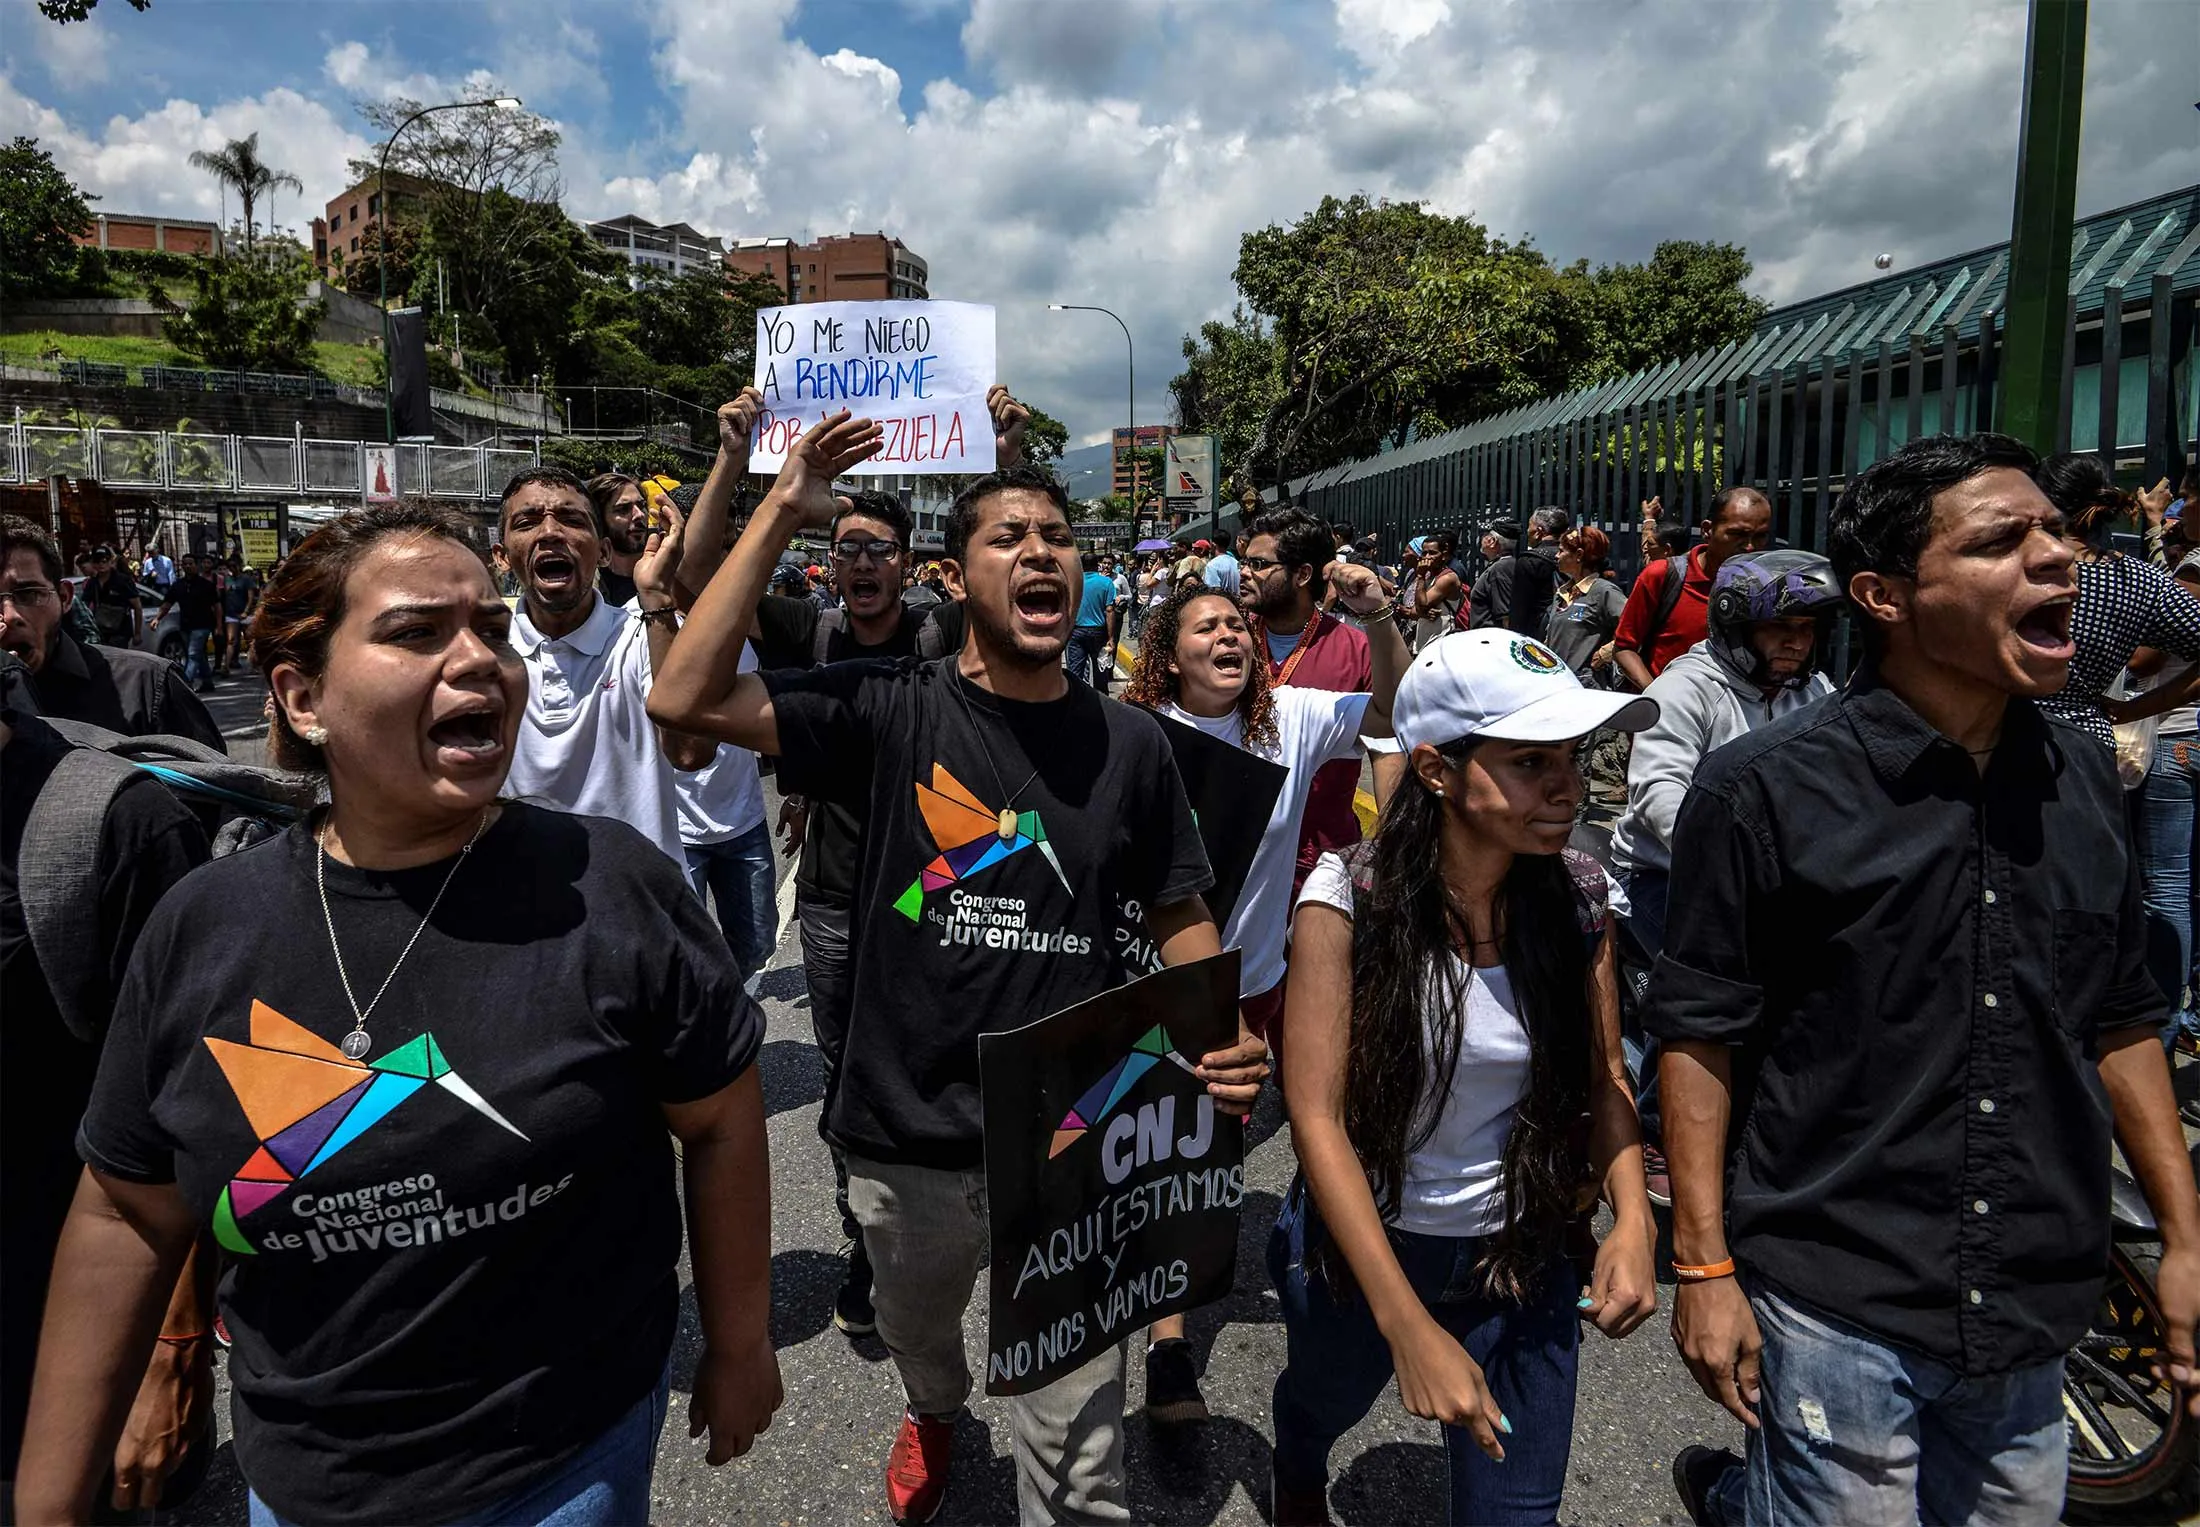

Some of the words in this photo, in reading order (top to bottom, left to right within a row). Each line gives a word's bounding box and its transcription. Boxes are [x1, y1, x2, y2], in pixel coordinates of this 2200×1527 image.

[761, 311, 795, 356] YO
[813, 317, 844, 354] ME
[762, 362, 781, 400] A
[949, 889, 1026, 913] Congreso
[956, 906, 1027, 929] Nacional
[927, 907, 945, 926] de
[939, 915, 1092, 955] Juventudes
[1101, 1094, 1215, 1184] CNJ
[262, 1231, 303, 1250] de
[304, 1172, 575, 1263] Juventudes
[291, 1173, 436, 1218] Congreso
[314, 1189, 445, 1232] Nacional
[1102, 1241, 1126, 1289] Y
[988, 1340, 1032, 1383] NO
[1038, 1311, 1085, 1371] NOS
[1094, 1259, 1189, 1333] VAMOS
